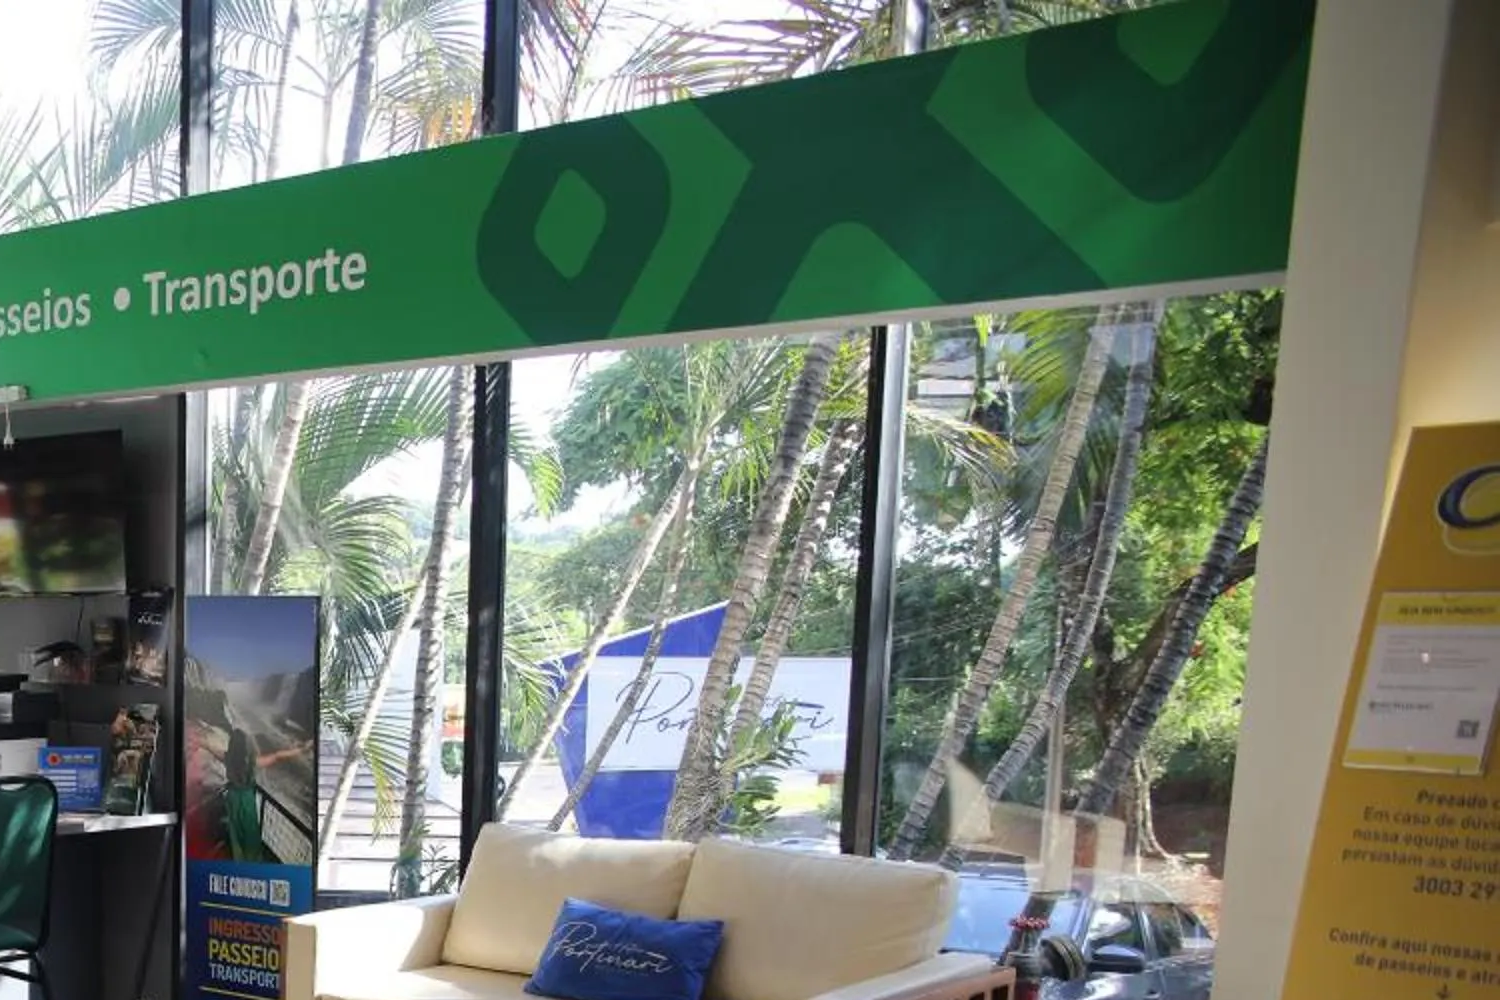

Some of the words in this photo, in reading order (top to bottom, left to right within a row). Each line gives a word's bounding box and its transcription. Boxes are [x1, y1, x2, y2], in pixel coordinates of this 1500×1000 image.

[143, 247, 368, 316] Transporte
[1362, 805, 1390, 824] Em
[209, 873, 229, 896] FALE
[1413, 875, 1464, 898] 3003
[1329, 927, 1387, 950] Confira
[1391, 935, 1428, 955] aqui
[1355, 953, 1375, 968] de
[1378, 956, 1451, 980] passeios
